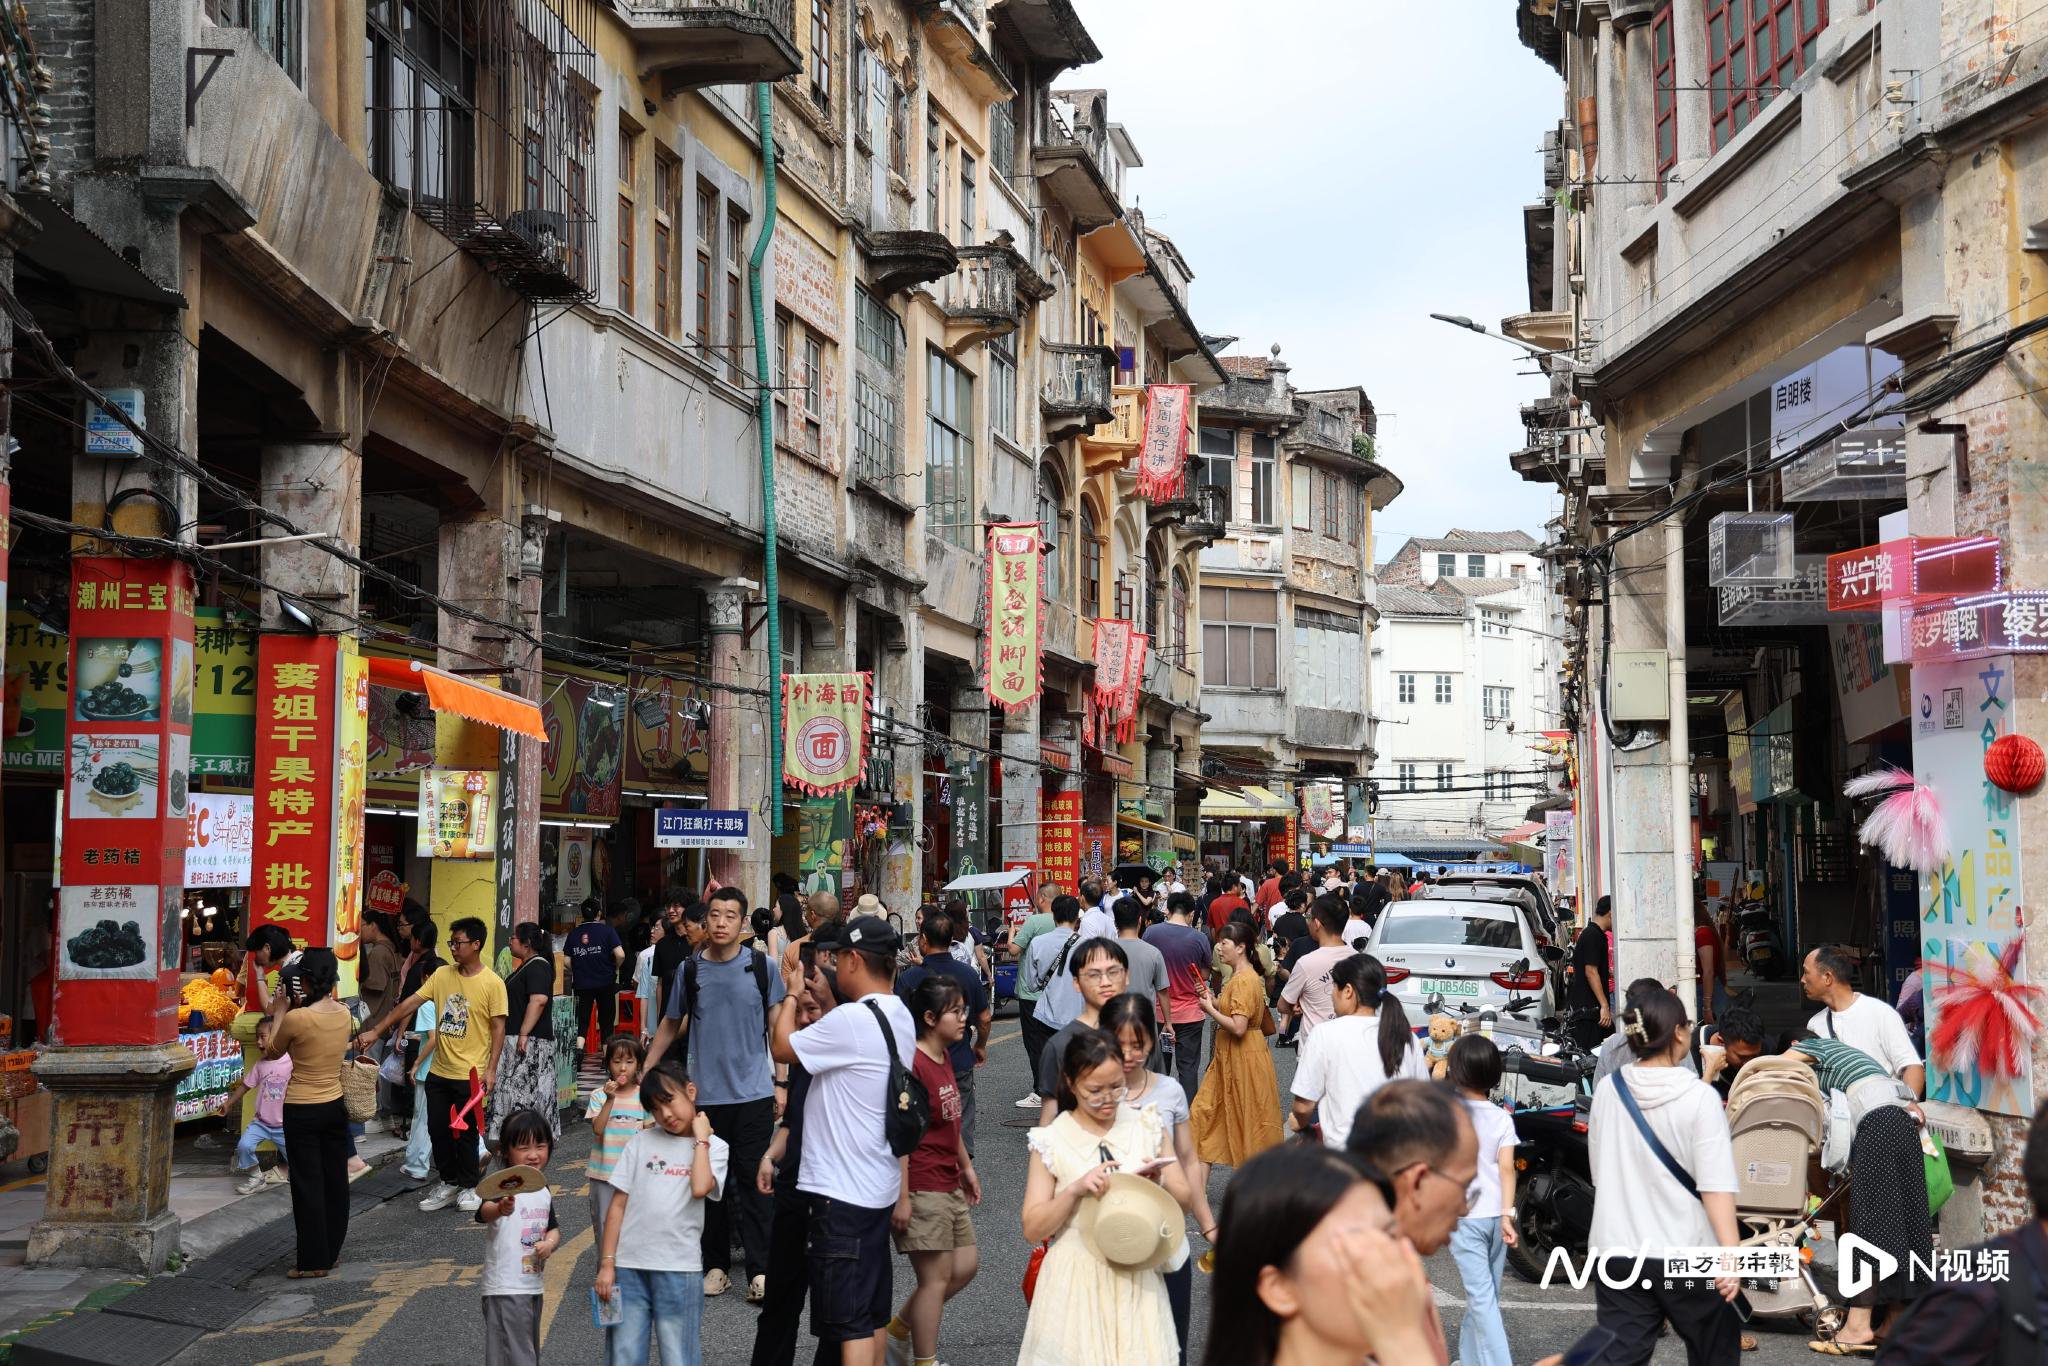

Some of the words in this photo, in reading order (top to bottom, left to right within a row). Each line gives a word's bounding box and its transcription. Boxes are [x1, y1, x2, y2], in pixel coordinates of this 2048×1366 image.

[1775, 377, 1812, 413] 启明楼
[1152, 395, 1175, 467] 老周鸡仔饼
[1840, 551, 1893, 599] 兴宁路
[77, 581, 169, 611] 潮州三宝
[792, 681, 860, 705] 外海面
[265, 662, 320, 847] 葵姐干果特产
[809, 731, 840, 760] 面
[663, 816, 744, 831] 江门狂飙打卡现场
[1044, 827, 1073, 838] 太阳膜
[83, 848, 142, 865] 老药桔
[1091, 840, 1103, 878] 老周鸡
[90, 886, 133, 900] 老药橘
[264, 862, 312, 922] 批发
